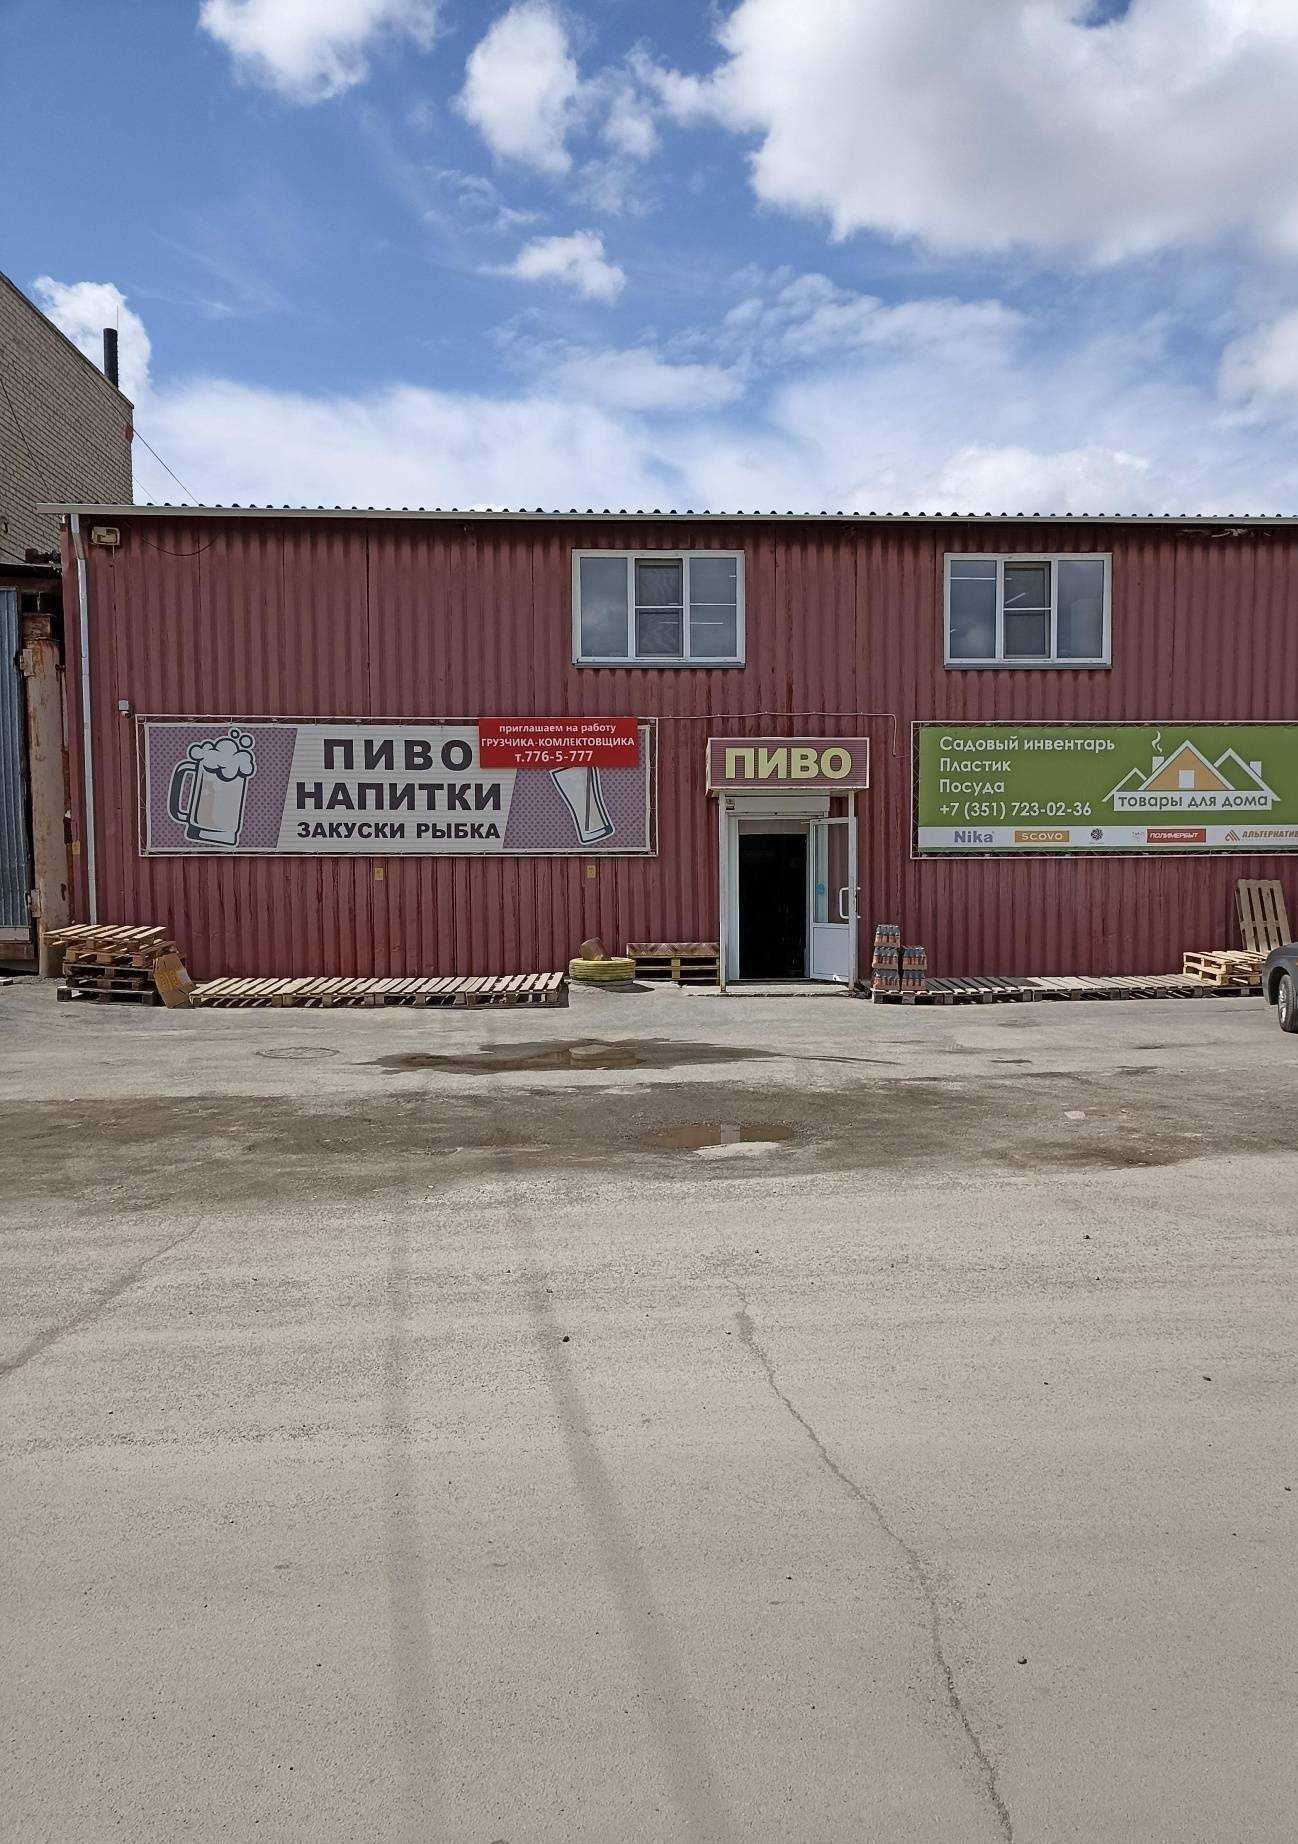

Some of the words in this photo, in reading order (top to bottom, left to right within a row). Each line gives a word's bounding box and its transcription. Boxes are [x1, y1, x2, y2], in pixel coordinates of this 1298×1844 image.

[499, 725, 563, 734] приглашаем
[581, 723, 616, 733] работу
[939, 736, 1019, 752] Садовый
[1024, 740, 1115, 753] инвентарь
[323, 738, 473, 771] ПИВО
[515, 751, 593, 762] т.776-5-777
[725, 747, 852, 780] ПИВО
[939, 758, 1011, 772] Пластик
[939, 779, 1005, 795] Посуда
[297, 783, 502, 811] НАПИТКИ
[1119, 796, 1182, 810] товары
[1187, 796, 1217, 809] для
[1221, 796, 1267, 809] дома
[939, 804, 959, 815] +7
[964, 802, 1006, 819] (351)
[1011, 803, 1092, 817] 723-02-36
[297, 821, 405, 839] ЗАКУСКИ
[416, 822, 501, 839] РЫБКА
[954, 831, 994, 843] Nika
